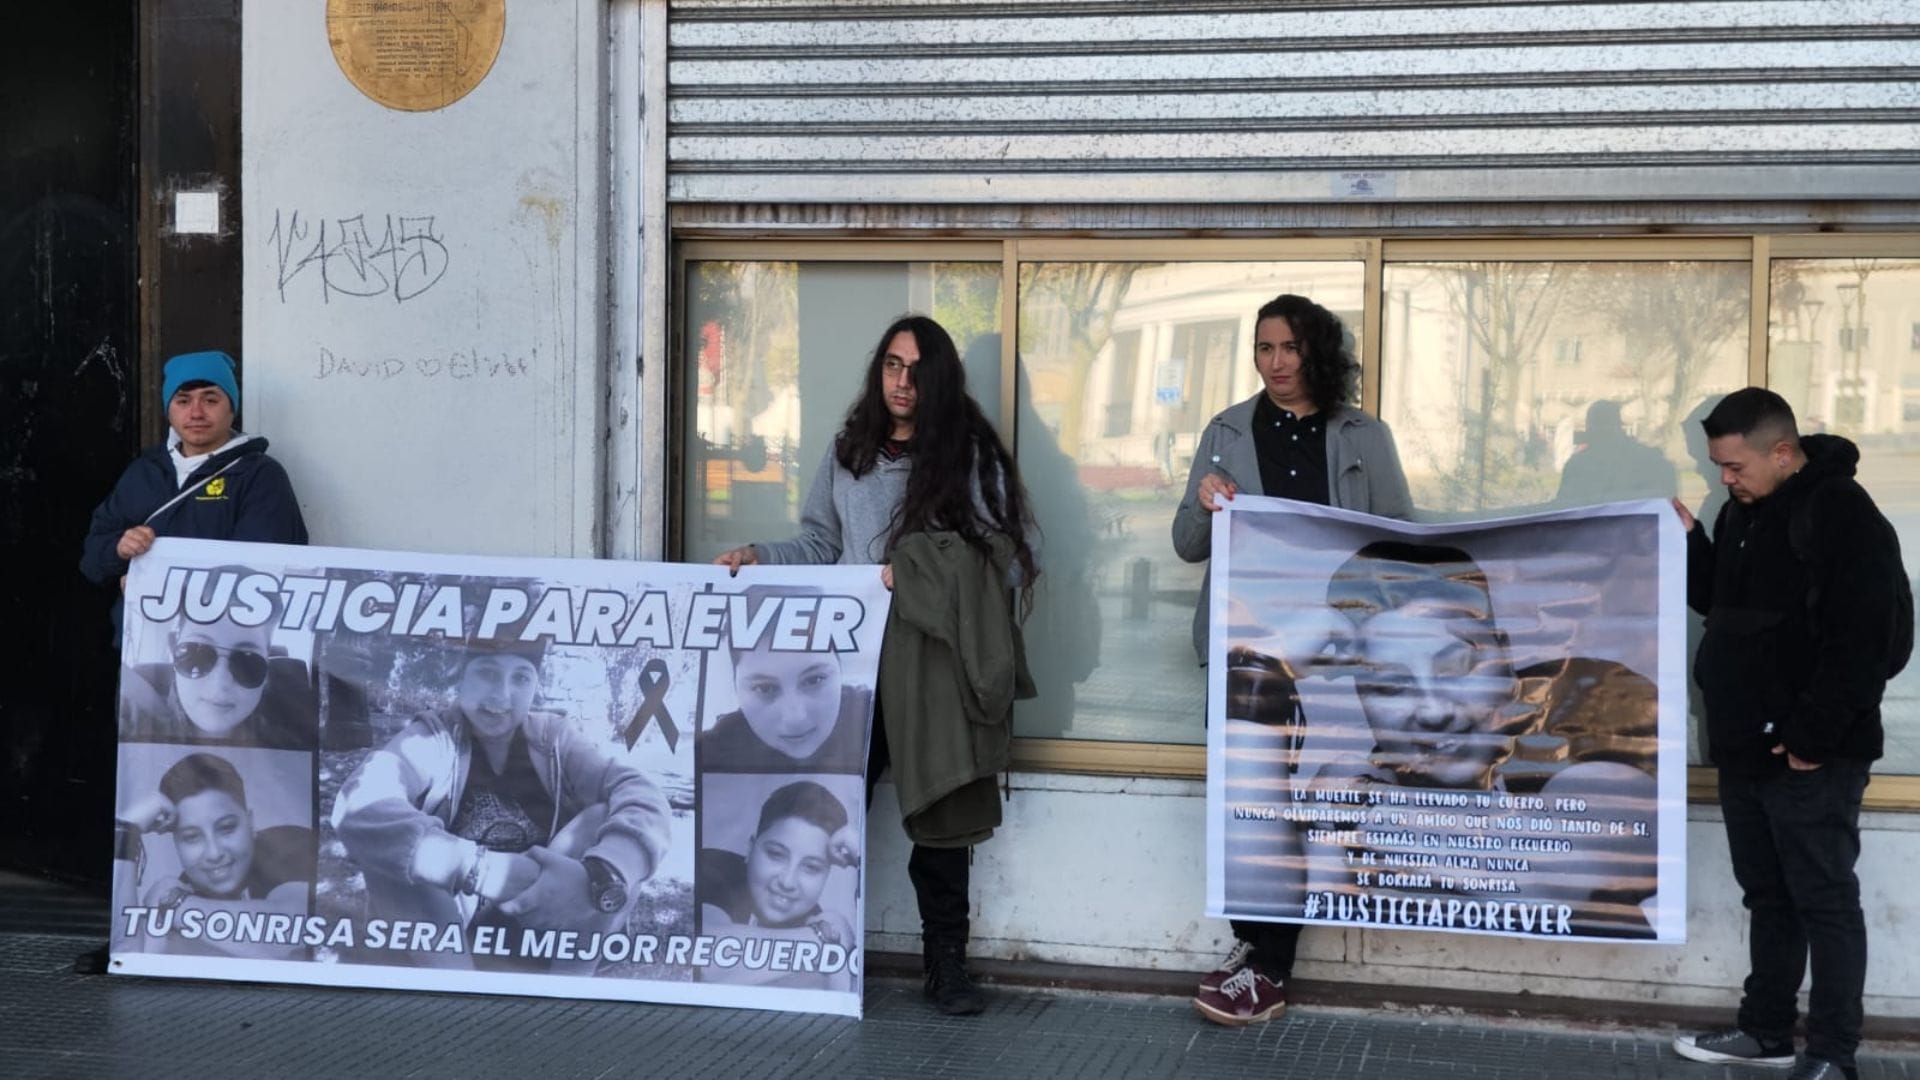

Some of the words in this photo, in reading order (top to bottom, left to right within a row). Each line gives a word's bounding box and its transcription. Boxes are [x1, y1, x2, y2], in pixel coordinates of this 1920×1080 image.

[140, 566, 467, 638] JUSTICIA
[474, 586, 674, 649] PARA
[682, 590, 865, 653] EVER
[1293, 789, 1308, 800] LA
[1315, 790, 1360, 803] MUERTE
[1368, 792, 1382, 804] SE
[1390, 793, 1407, 805] HA
[1415, 792, 1468, 807] LLEVADO
[1475, 795, 1491, 808] TU
[1555, 799, 1587, 812] PERO
[1234, 806, 1276, 820] NUNCA
[1283, 808, 1367, 824] OLVIDAREMOS
[1374, 814, 1383, 825] A
[1391, 813, 1408, 825] UN
[1416, 814, 1457, 828] AMIGO
[1465, 815, 1489, 829] QUE
[1497, 817, 1522, 831] NOS
[1560, 819, 1602, 834] TANTO
[1609, 821, 1625, 836] DE
[1307, 830, 1358, 844] SIEMPRE
[1366, 830, 1415, 847] ESTARÁS
[1423, 834, 1440, 848] EN
[1448, 836, 1502, 850] NUESTRO
[1510, 838, 1572, 853] RECUERDO
[1346, 852, 1354, 865] Y
[1362, 853, 1377, 866] DE
[1384, 854, 1438, 868] NUESTRA
[1445, 855, 1479, 870] ALMA
[1486, 858, 1530, 872] NUNCA
[1356, 873, 1371, 886] SE
[1378, 873, 1433, 888] BORRARÁ
[1440, 876, 1455, 890] TU
[1462, 878, 1521, 893] SONRISA.
[1304, 892, 1573, 935] #JUSTICIAPOREVER
[123, 907, 174, 937] TU
[180, 911, 355, 949] SONRISA
[364, 919, 465, 955] SERA
[472, 925, 513, 957] EL
[519, 928, 659, 965] MEJOR
